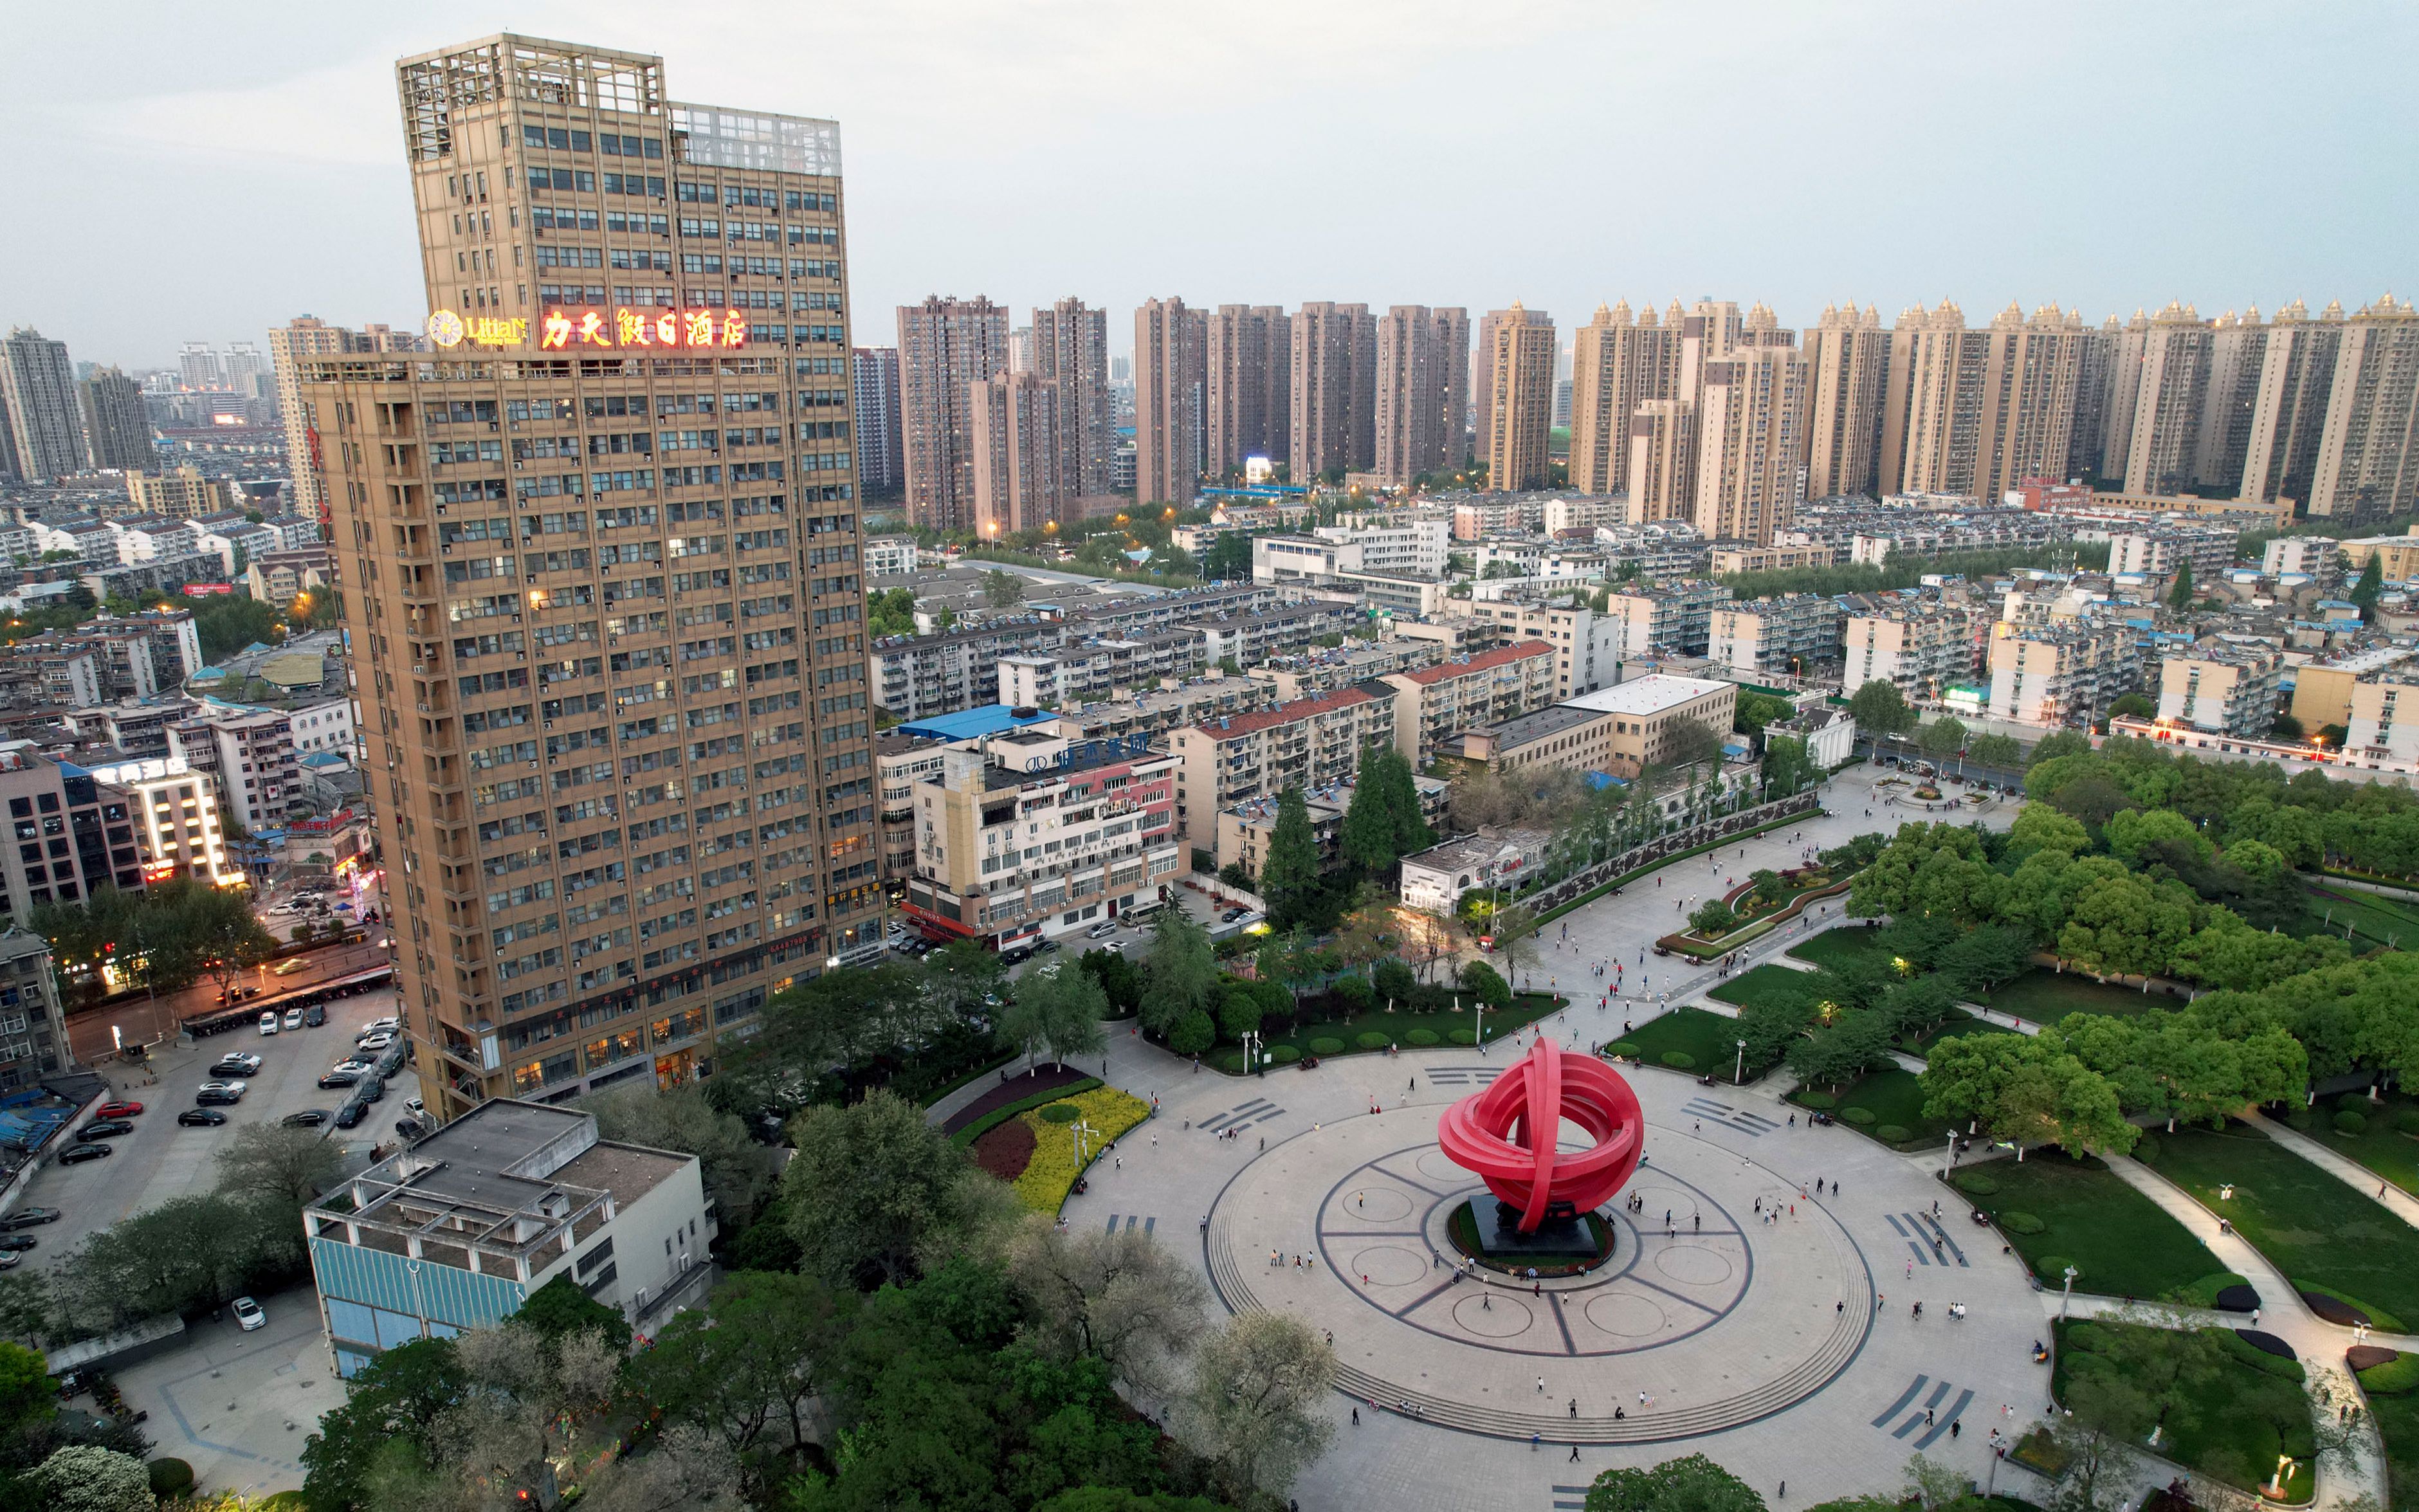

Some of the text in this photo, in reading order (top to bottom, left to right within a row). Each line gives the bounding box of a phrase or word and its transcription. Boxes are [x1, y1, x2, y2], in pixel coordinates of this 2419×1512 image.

[542, 308, 745, 349] 力天假日酒店
